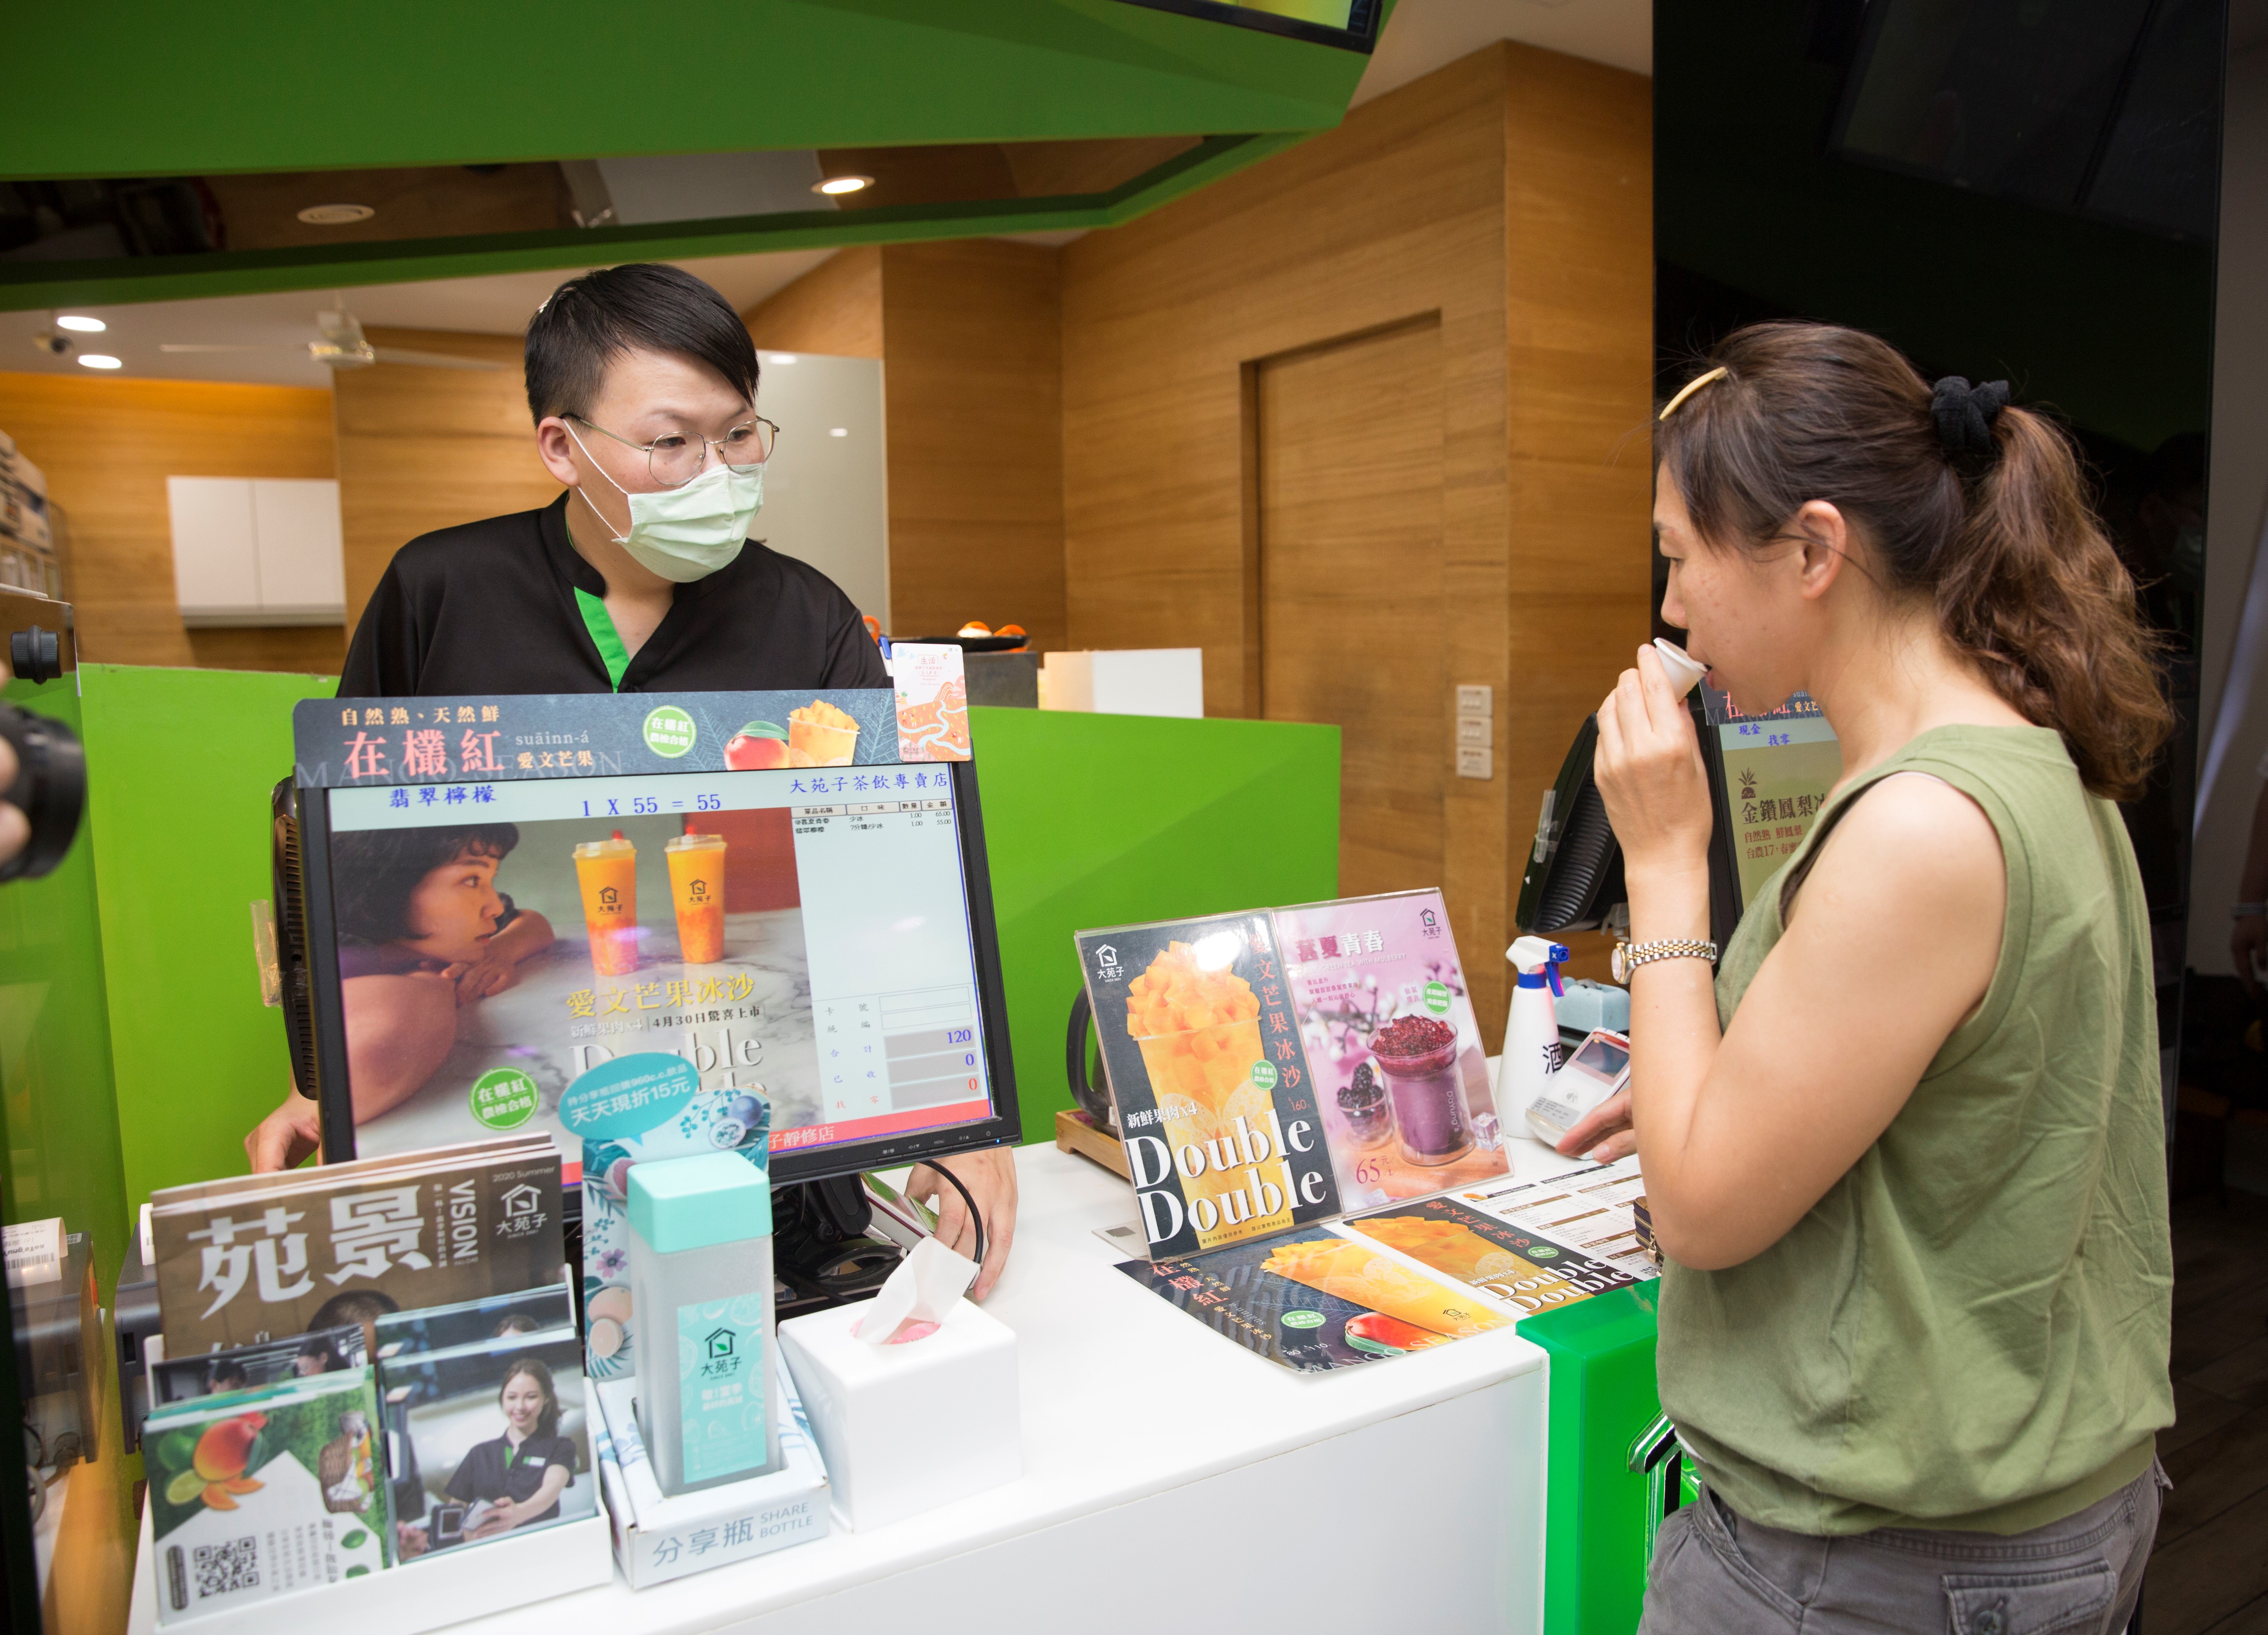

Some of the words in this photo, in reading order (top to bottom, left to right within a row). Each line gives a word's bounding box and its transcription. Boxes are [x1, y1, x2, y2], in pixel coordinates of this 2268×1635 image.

[341, 705, 500, 726] 自然熟、天然鮮
[1794, 701, 1822, 713] 愛文芒
[516, 730, 589, 746] suāinn-á
[1739, 723, 1760, 735] 現金
[1769, 734, 1790, 746] 找零
[344, 729, 505, 779] 在欉紅
[517, 749, 593, 770] 愛文芒果
[790, 772, 947, 794] 大苑子茶飲專賣店
[389, 786, 497, 808] 翡翠檸檬
[583, 800, 591, 817] 1
[634, 797, 659, 814] 55
[672, 800, 683, 808] =
[697, 794, 721, 811] 55
[1744, 829, 1771, 843] 自然熟
[1422, 926, 1442, 936] 大苑子
[1375, 953, 1406, 963] MULBERRY
[1097, 966, 1124, 980] 大苑子
[566, 972, 754, 1020] 愛文芒果冰沙
[825, 1003, 869, 1016] 卡號
[1249, 933, 1302, 1088] 愛文芒果冰沙
[827, 1020, 871, 1034] 統編
[569, 1028, 763, 1080] Dble
[830, 1045, 873, 1058] 合計
[946, 1029, 972, 1044] 120
[833, 1070, 876, 1084] 已收
[965, 1053, 975, 1067] 0
[571, 1076, 691, 1127] 天天現折15元
[835, 1095, 879, 1110] 找零
[968, 1077, 978, 1091] 0
[1291, 1099, 1307, 1111] 160
[1126, 1101, 1198, 1129] 新鮮果肉x4
[768, 1125, 834, 1149] 子靜修店
[1124, 1108, 1314, 1190] Double
[517, 1166, 555, 1179] Summer
[1356, 1157, 1381, 1184] 65
[1137, 1159, 1327, 1245] Double
[450, 1179, 479, 1259] VISION
[495, 1213, 548, 1236] 大苑子
[1425, 1201, 1530, 1248] 愛文芒果冰沙
[188, 1185, 433, 1320] 苑景
[1476, 1259, 1607, 1300] Double
[1502, 1270, 1634, 1313] Double
[1296, 1347, 1406, 1374] MANGO
[1409, 1315, 1516, 1351] SEASON
[701, 1356, 742, 1377] 大苑子
[760, 1502, 809, 1524] SHARE
[760, 1515, 814, 1539] BOTTLE
[653, 1517, 755, 1567] 分享瓶
